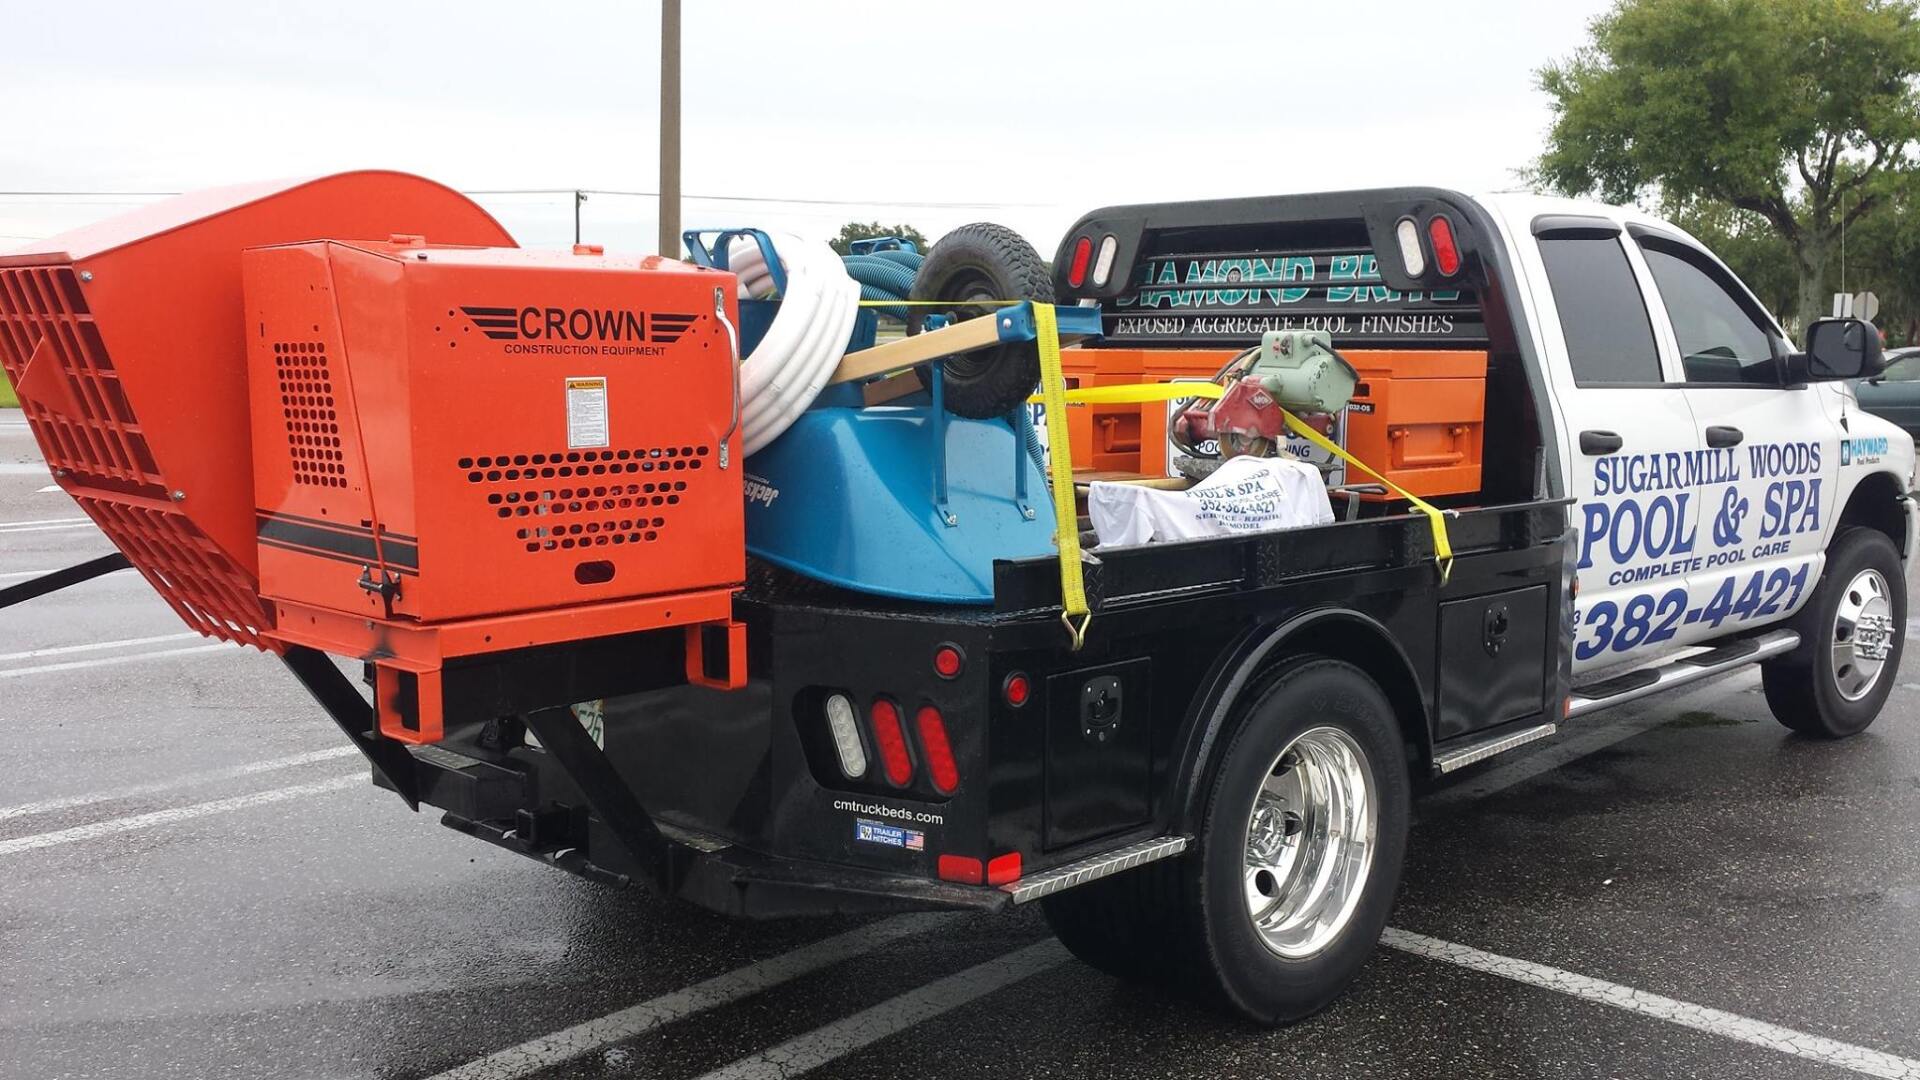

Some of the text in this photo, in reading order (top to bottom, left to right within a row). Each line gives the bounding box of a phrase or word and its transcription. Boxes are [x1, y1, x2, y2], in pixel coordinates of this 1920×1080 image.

[519, 306, 646, 342] CROWN
[1117, 315, 1454, 334] EXPOSED AGGREGATE POOL FINISHES
[504, 344, 666, 356] CONSTRUCTION EQUIPMENT
[1851, 437, 1888, 456] HAYWARD
[1594, 448, 1740, 496] SUGARMILL
[1748, 442, 1821, 479] WOODS
[1237, 480, 1264, 496] SPA
[1576, 478, 1823, 570] POOL & SPA
[1608, 540, 1792, 586] COMPLETE POOL CARE
[1575, 563, 1810, 660] 382-4421
[833, 800, 944, 825] cmtruckbeds.com
[872, 827, 902, 838] TRAILER
[872, 835, 903, 846] HITCHES
